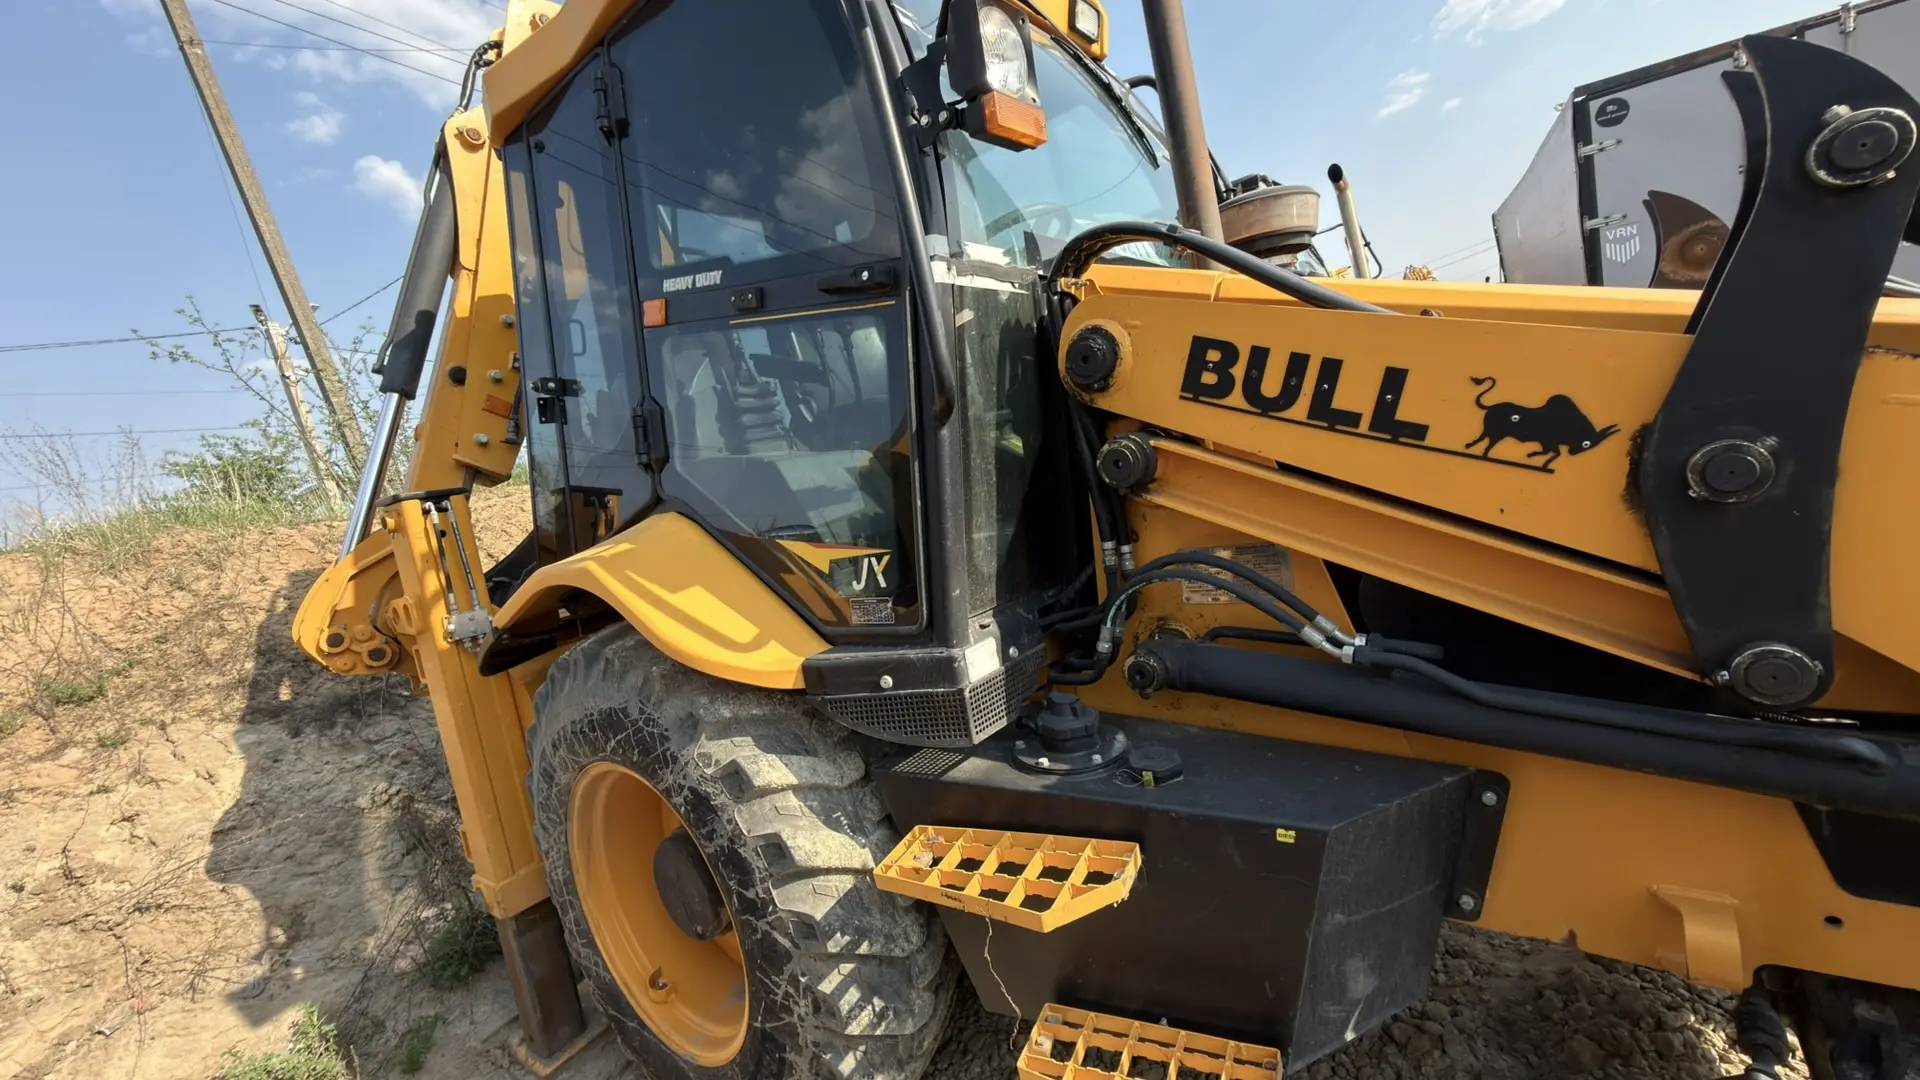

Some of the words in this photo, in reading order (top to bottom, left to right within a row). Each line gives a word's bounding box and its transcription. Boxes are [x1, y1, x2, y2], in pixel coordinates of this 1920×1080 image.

[1606, 224, 1637, 240] VRN
[663, 275, 694, 293] HEAVY
[695, 270, 722, 288] DUTY
[1181, 335, 1430, 442] BULL
